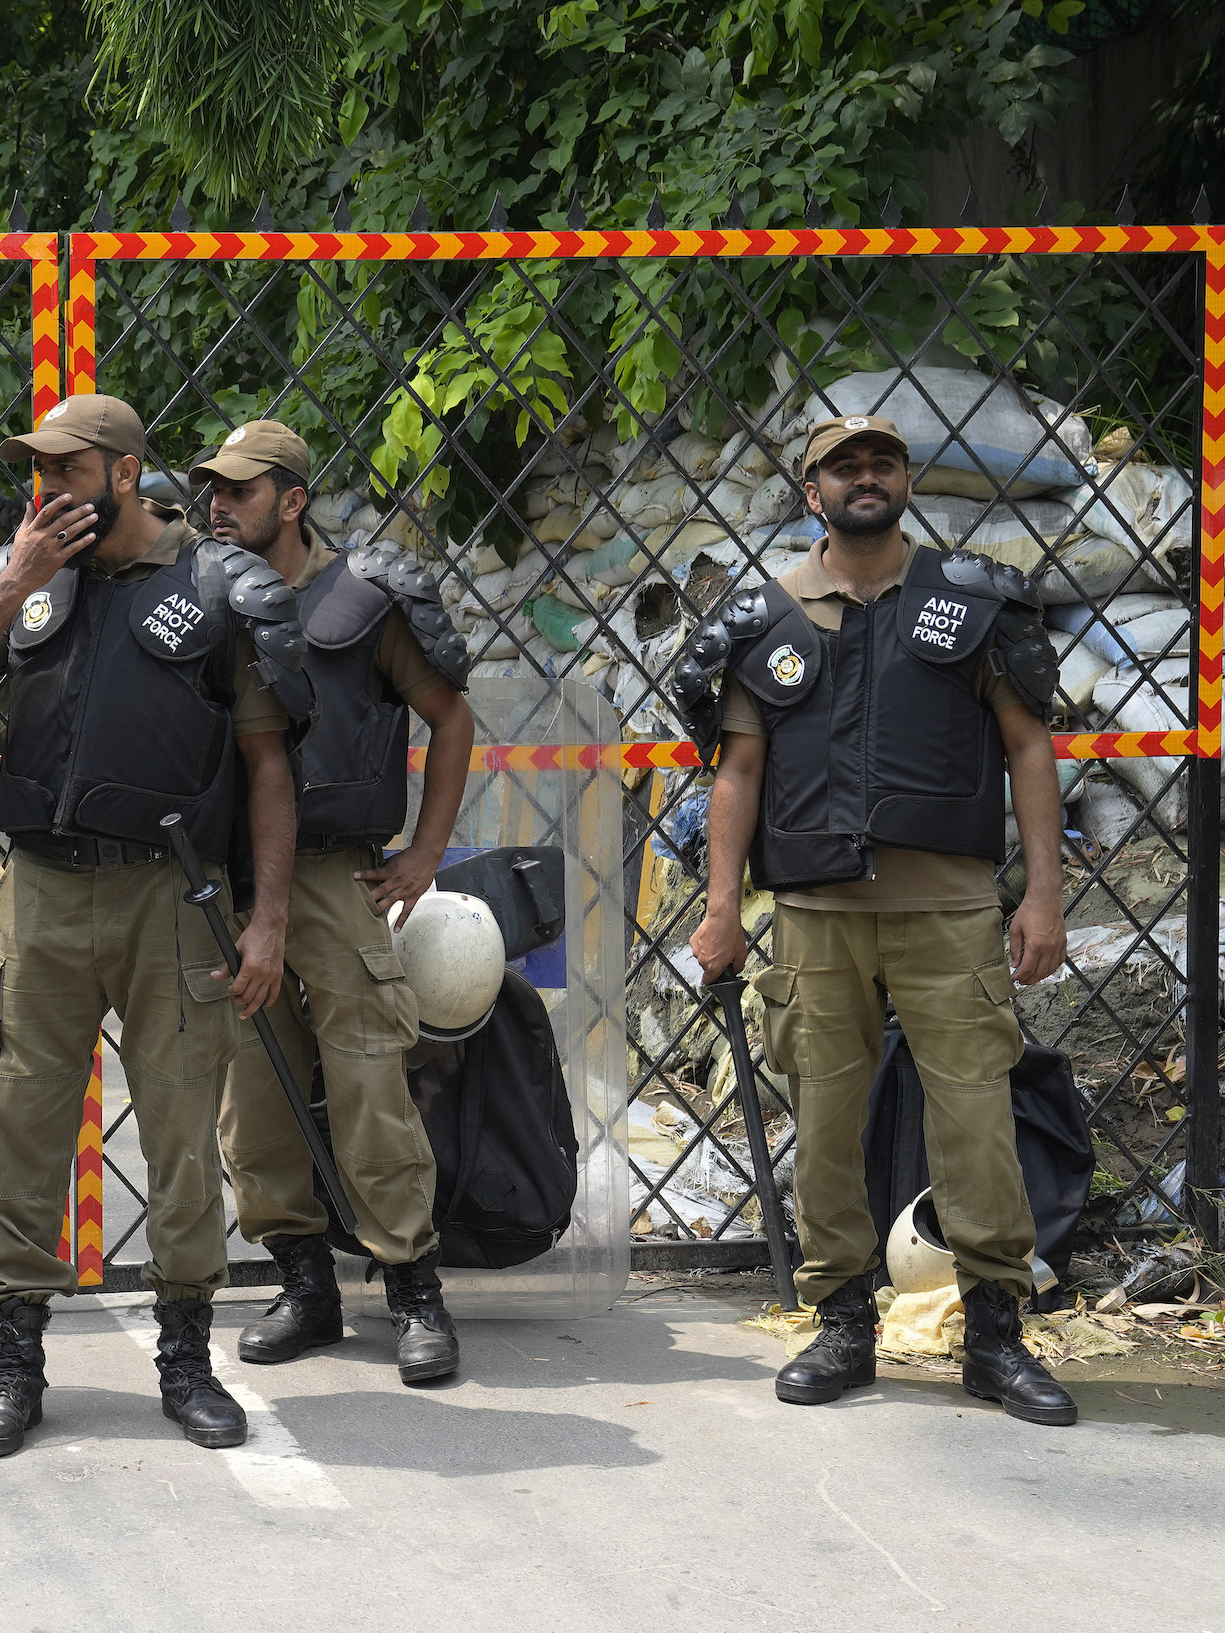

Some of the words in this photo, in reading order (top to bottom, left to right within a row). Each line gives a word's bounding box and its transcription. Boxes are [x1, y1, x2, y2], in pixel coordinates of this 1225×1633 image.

[153, 603, 194, 635] RIOT
[163, 593, 205, 625] ANTI
[918, 611, 963, 633] RIOT
[924, 597, 967, 619] ANTI
[142, 615, 183, 651] FORCE
[912, 625, 957, 650] FORCE
